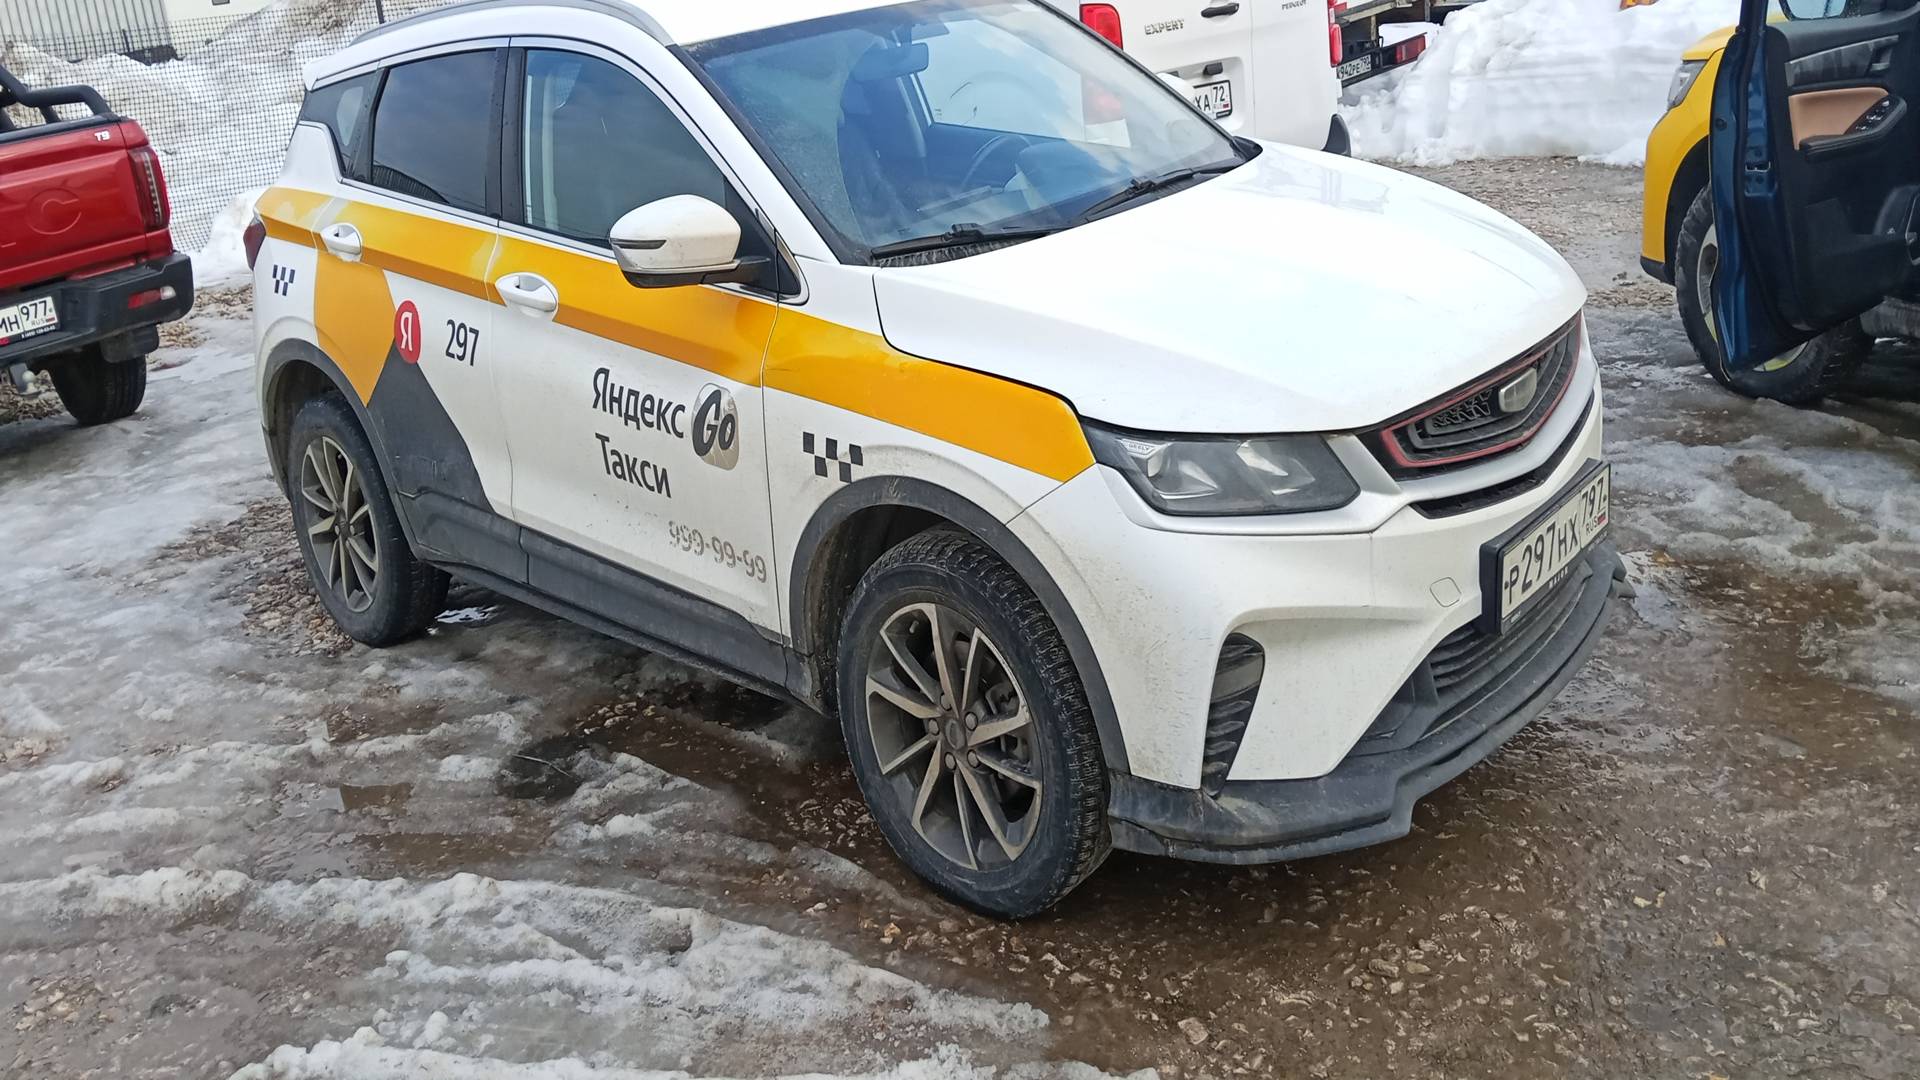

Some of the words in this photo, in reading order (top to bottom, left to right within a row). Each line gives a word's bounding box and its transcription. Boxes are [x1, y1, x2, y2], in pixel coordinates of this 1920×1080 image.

[1144, 18, 1185, 35] EXPERT
[1212, 85, 1226, 103] 72
[94, 130, 111, 141] T9
[20, 300, 48, 321] 977
[445, 319, 480, 367] 297
[592, 367, 686, 439] Яндекс
[691, 389, 736, 458] Go
[595, 432, 672, 499] Такси
[1581, 476, 1605, 526] 797
[1585, 514, 1599, 536] RUS
[668, 520, 767, 584] 999-99-99
